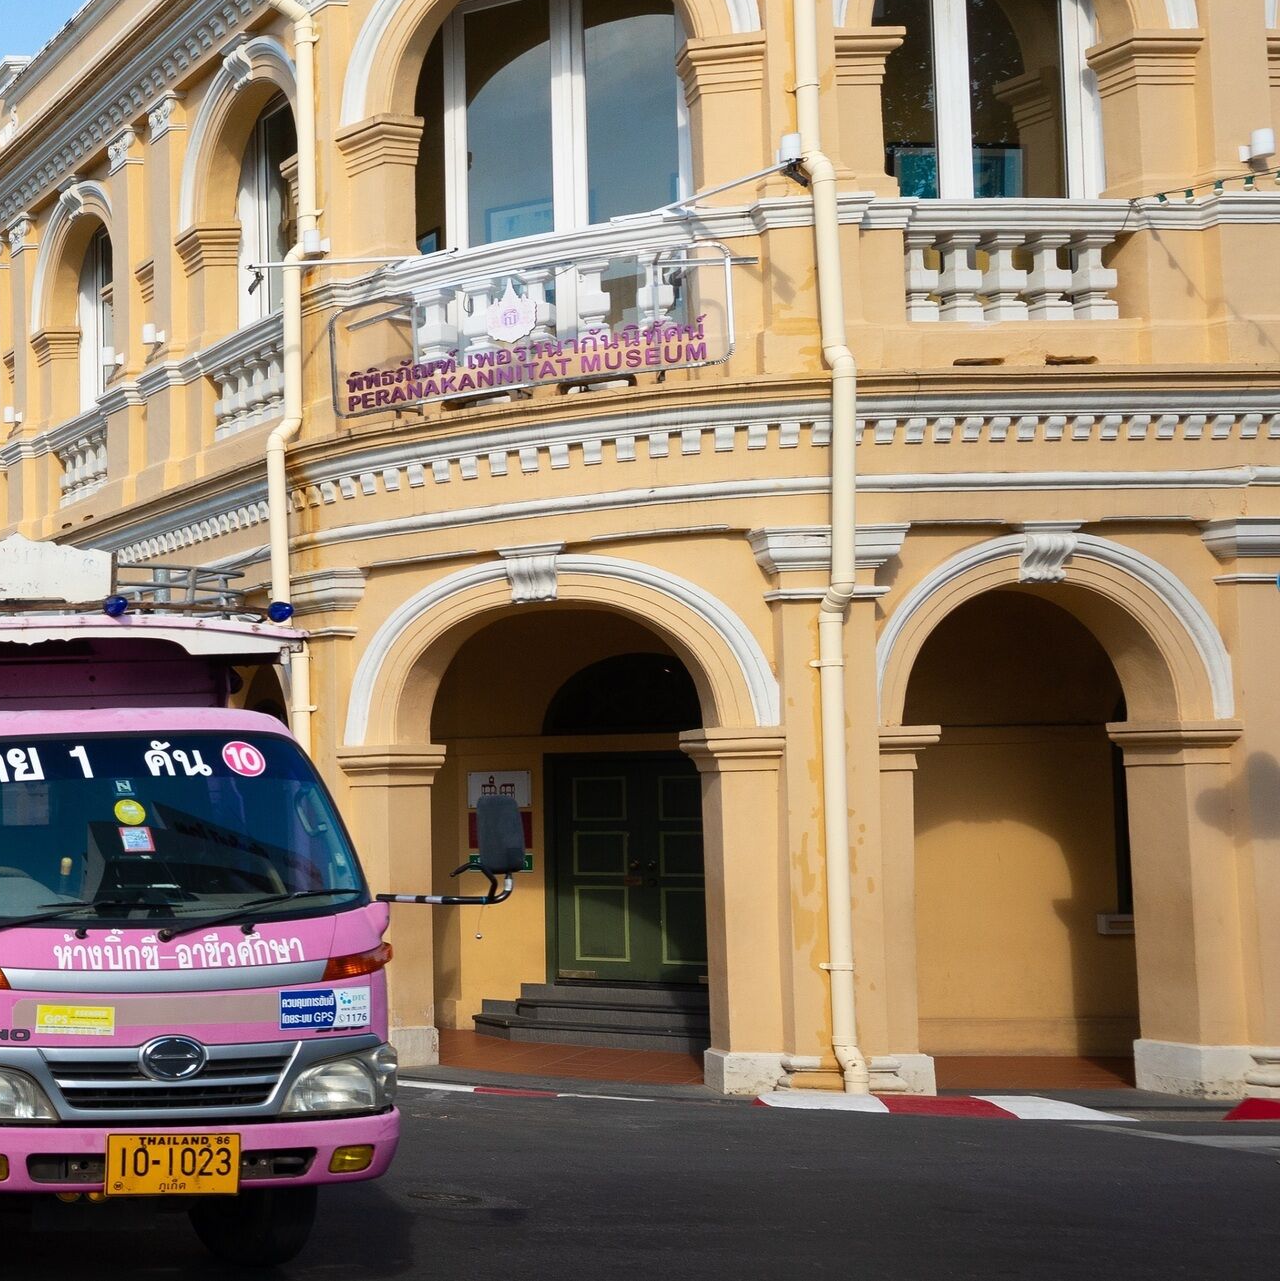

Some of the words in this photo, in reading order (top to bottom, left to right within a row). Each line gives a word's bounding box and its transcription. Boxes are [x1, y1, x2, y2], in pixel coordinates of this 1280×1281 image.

[346, 349, 459, 393] พิพิธภัณฑ์
[468, 314, 707, 369] เพอรานากันนิทัศน์
[347, 358, 571, 412] PERANAKANNITAT
[581, 342, 707, 373] MUSEUM
[69, 745, 94, 779] 1
[144, 740, 213, 777] คัน
[226, 746, 260, 771] 10
[282, 993, 334, 1009] ควบคุมการขับขี่
[282, 1013, 312, 1024] โดยระบบ
[313, 1011, 334, 1023] GPS
[346, 1013, 368, 1023] 1176
[139, 1136, 209, 1145] THAILAND
[121, 1147, 232, 1176] 10-1023
[158, 1179, 186, 1192] ภูเก็ต
